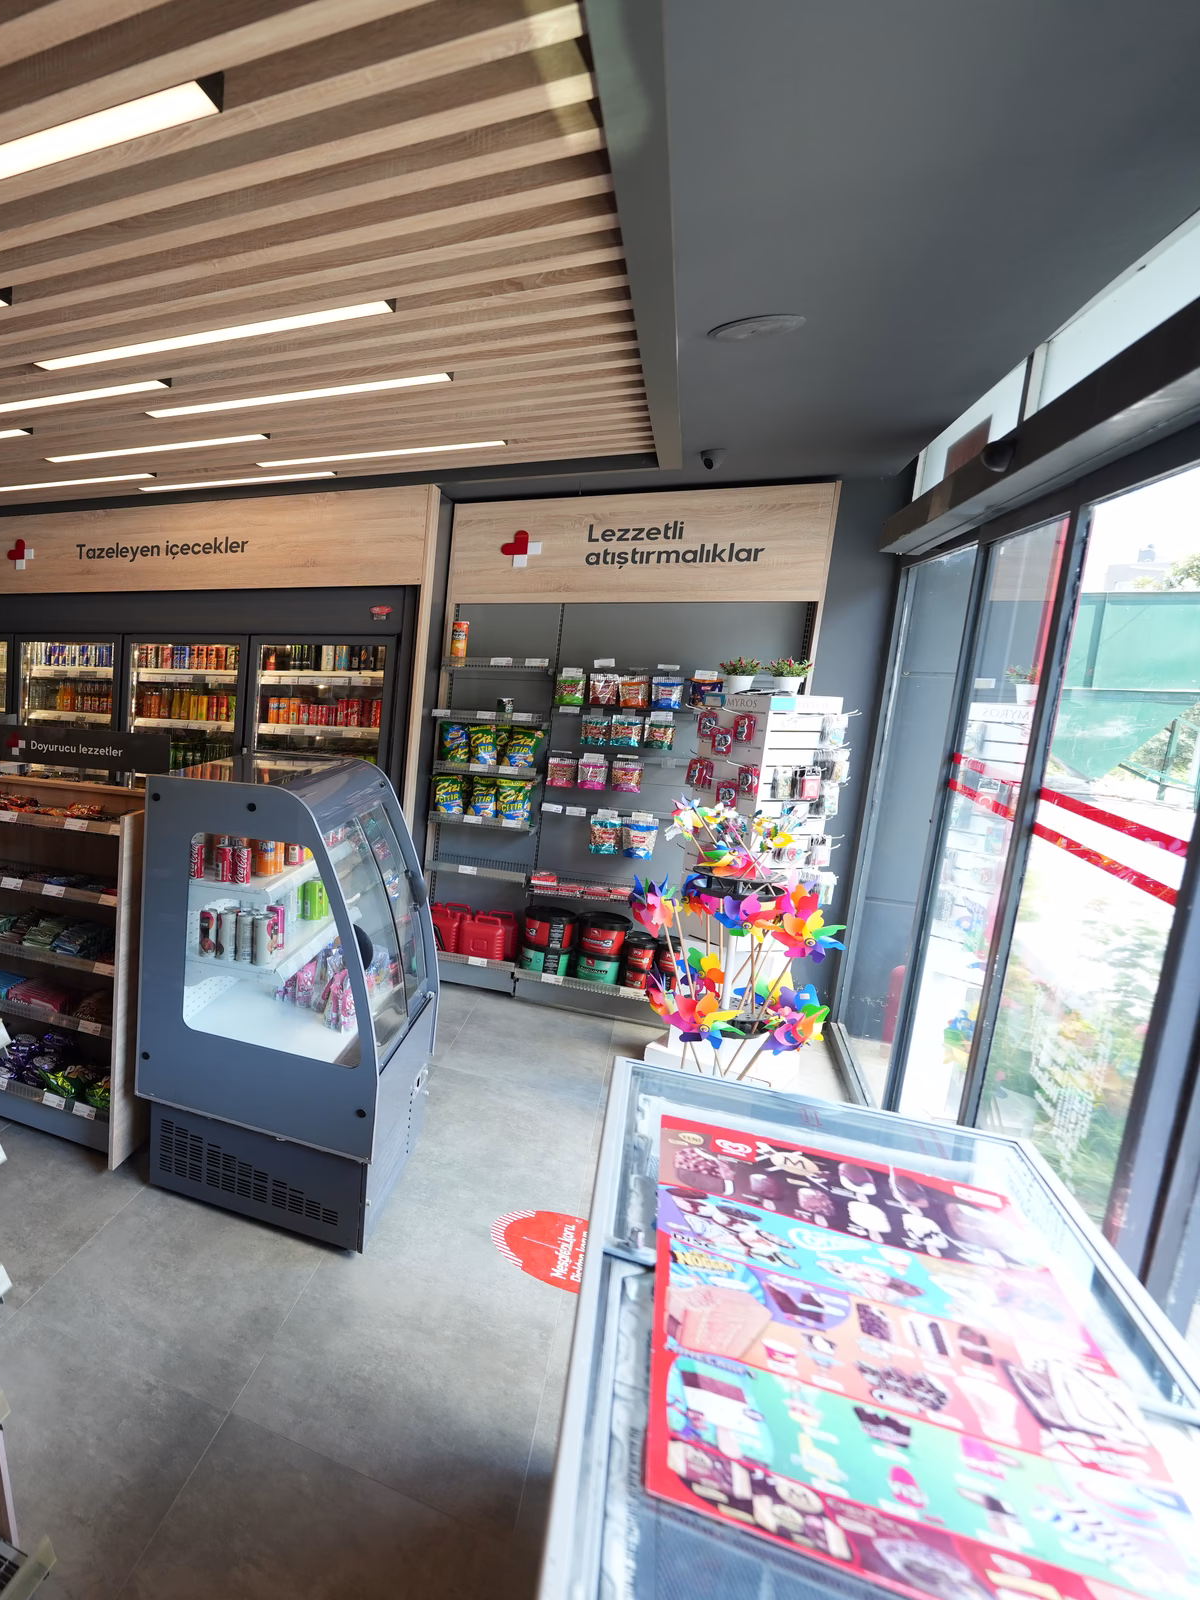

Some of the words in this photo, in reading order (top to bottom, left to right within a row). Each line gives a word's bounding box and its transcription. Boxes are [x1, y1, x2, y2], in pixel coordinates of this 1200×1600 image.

[587, 520, 685, 543] Lezzetli
[76, 542, 160, 563] Tazeleyen
[165, 536, 249, 561] içecekler
[585, 543, 766, 570] atıştırmalıklar
[726, 698, 758, 708] MYROS
[30, 740, 76, 754] Doyurucu
[79, 743, 124, 757] lezzetler
